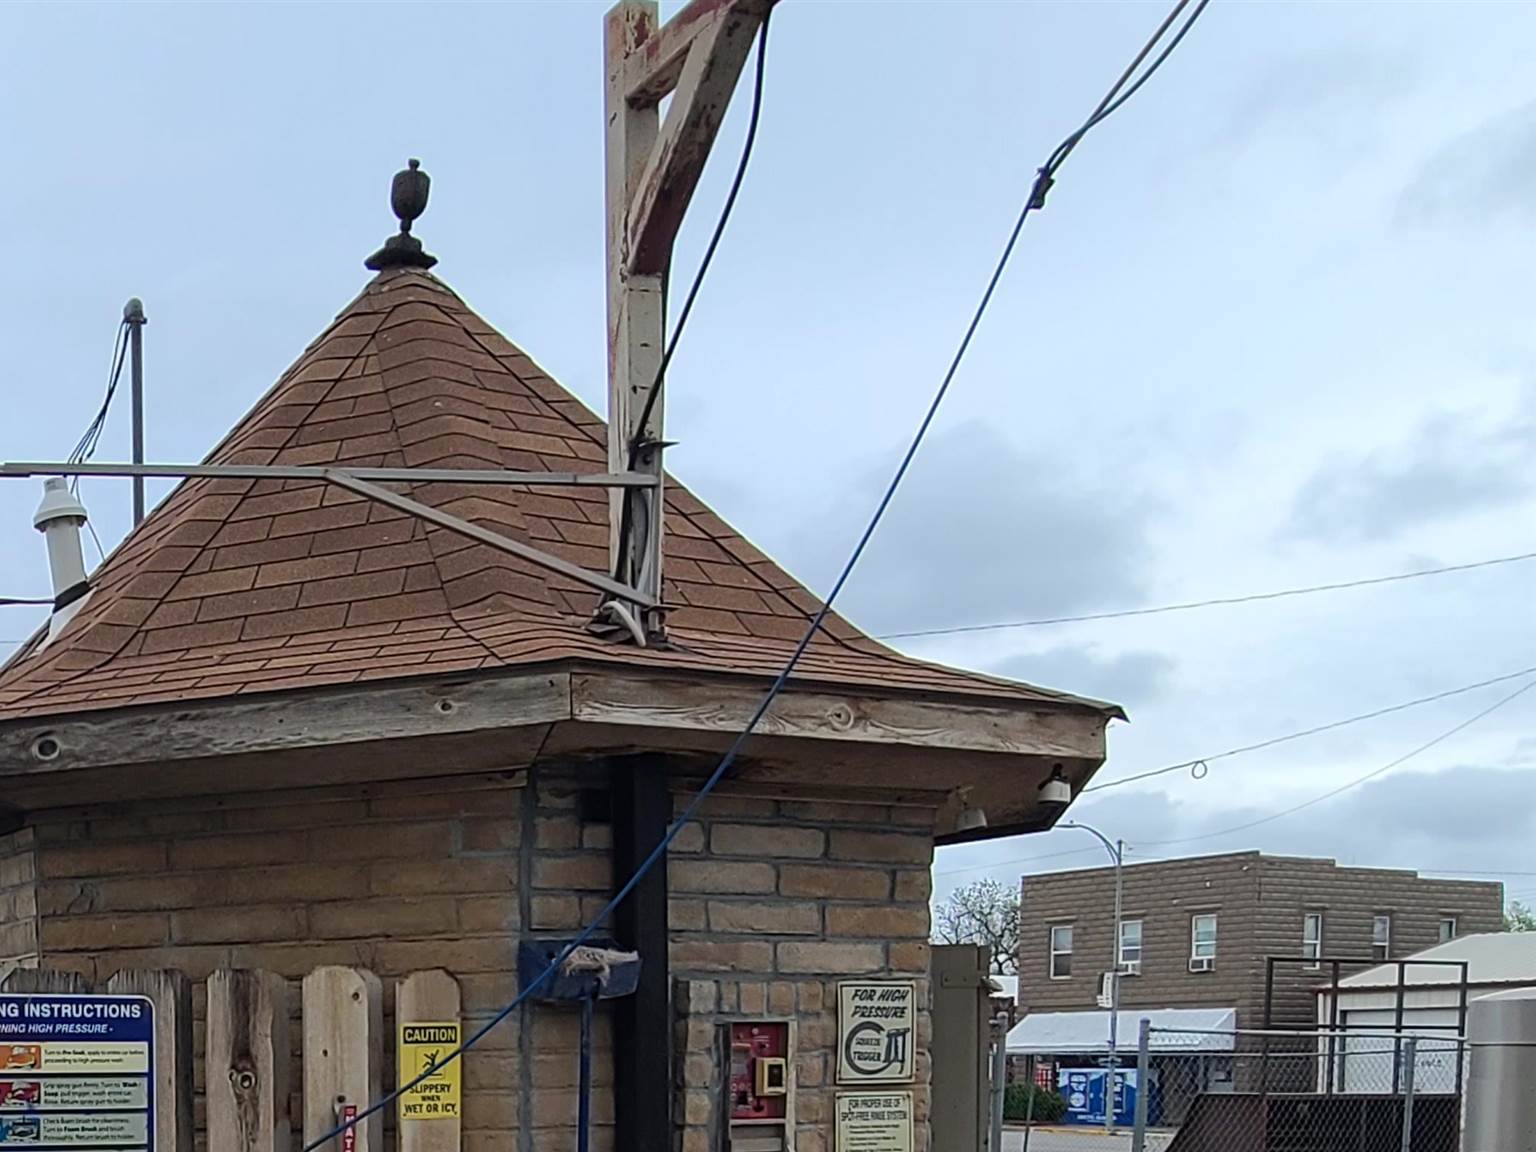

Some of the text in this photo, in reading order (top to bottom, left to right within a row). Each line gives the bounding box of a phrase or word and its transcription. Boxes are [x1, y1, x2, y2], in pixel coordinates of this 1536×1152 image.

[851, 989, 910, 1001] FOR HIGH
[24, 1003, 141, 1018] INSTRUCTIONS
[851, 1005, 908, 1018] PRESSURE
[28, 1024, 54, 1033] HIGH
[55, 1024, 108, 1033] PRESSURE
[405, 1028, 456, 1042] CAUTION
[853, 1051, 881, 1061] TRIGGER
[409, 1083, 451, 1094] SLIPPERY
[405, 1103, 456, 1113] WET OR ICY
